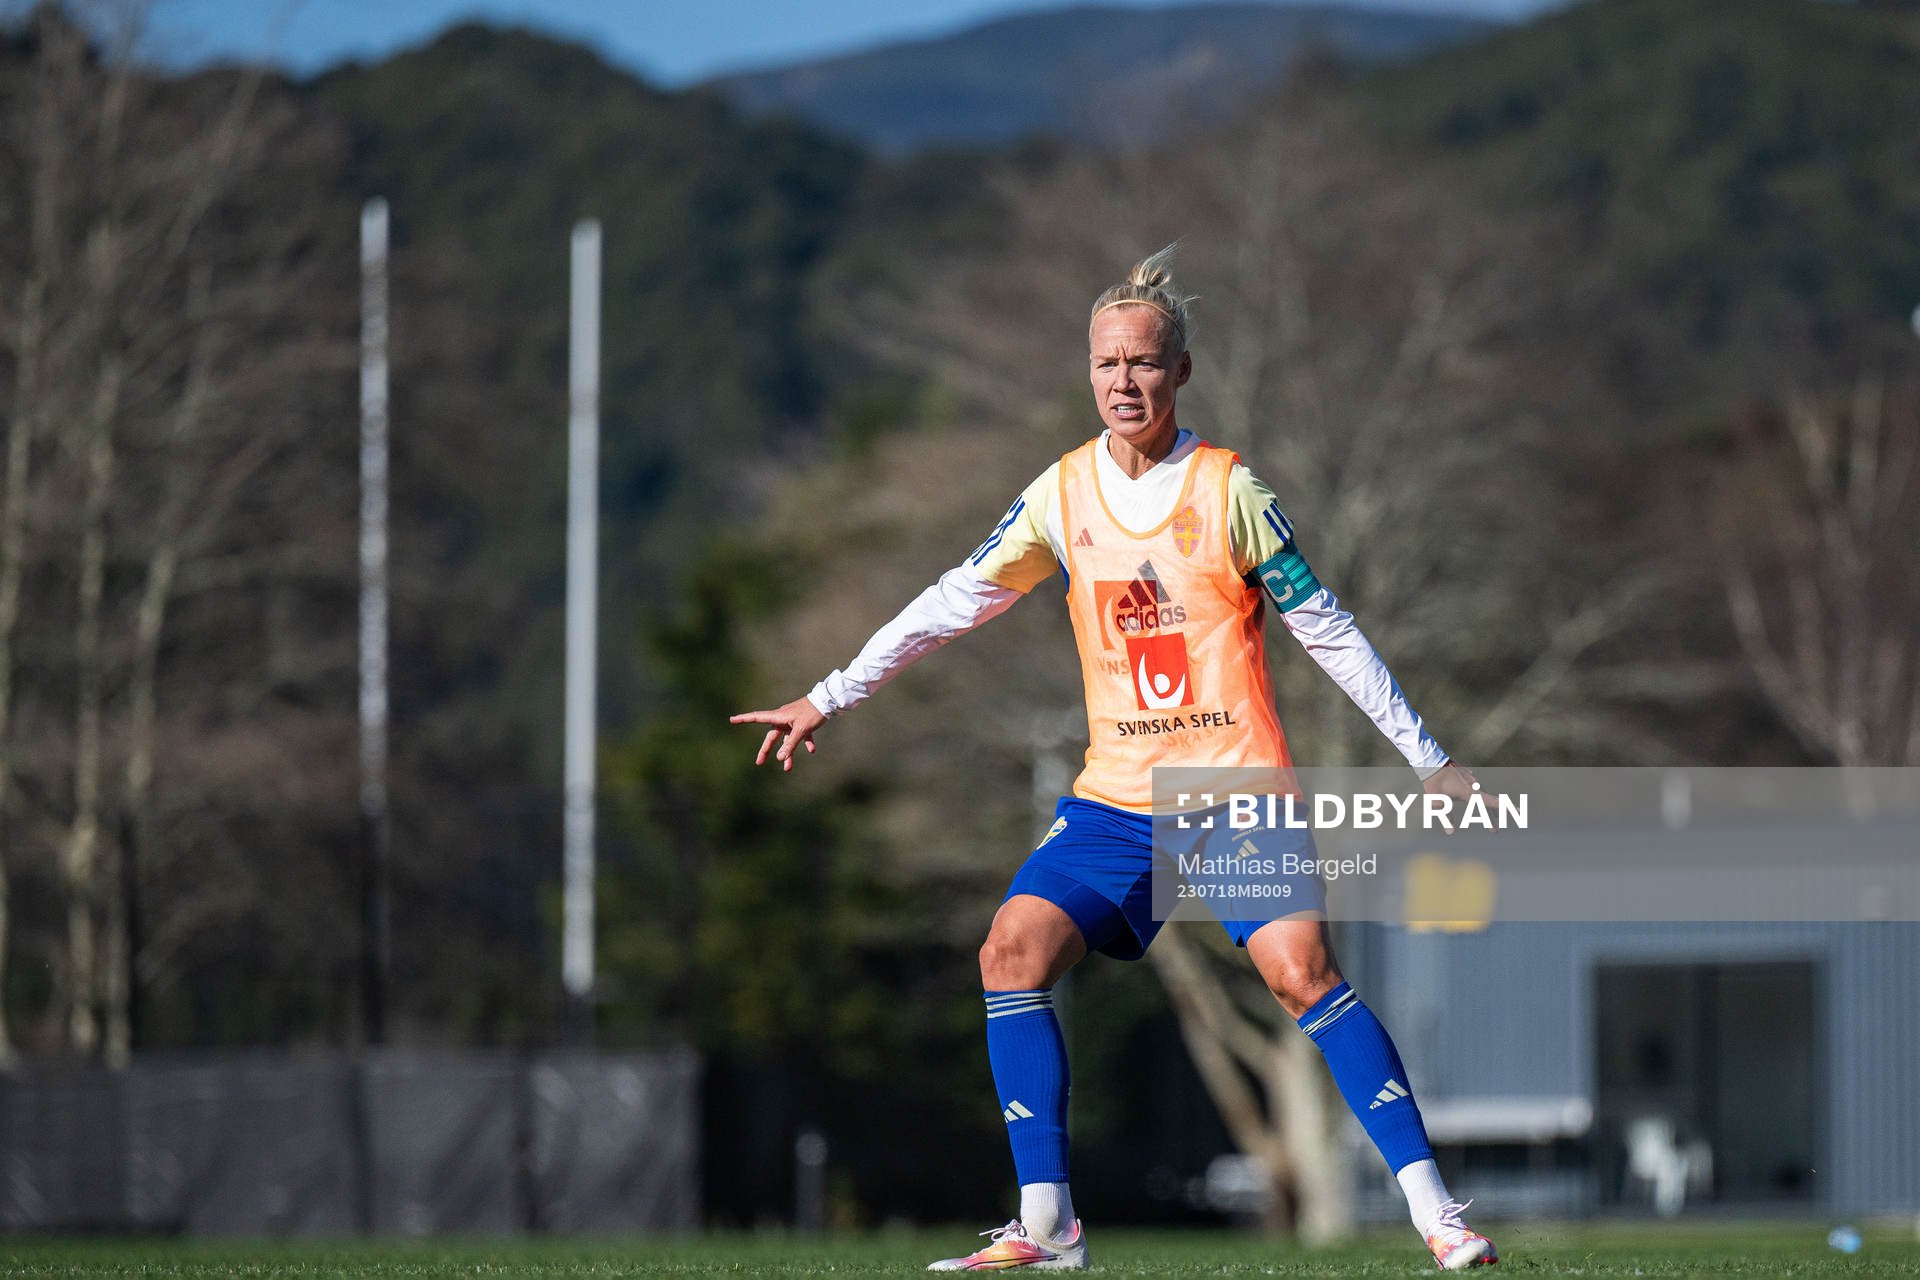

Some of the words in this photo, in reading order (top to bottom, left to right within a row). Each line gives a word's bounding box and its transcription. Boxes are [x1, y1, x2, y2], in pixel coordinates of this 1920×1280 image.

[1260, 569, 1294, 603] C
[1116, 604, 1187, 633] adidas
[1117, 717, 1186, 736] SVENSKA
[1189, 711, 1237, 728] SPEL
